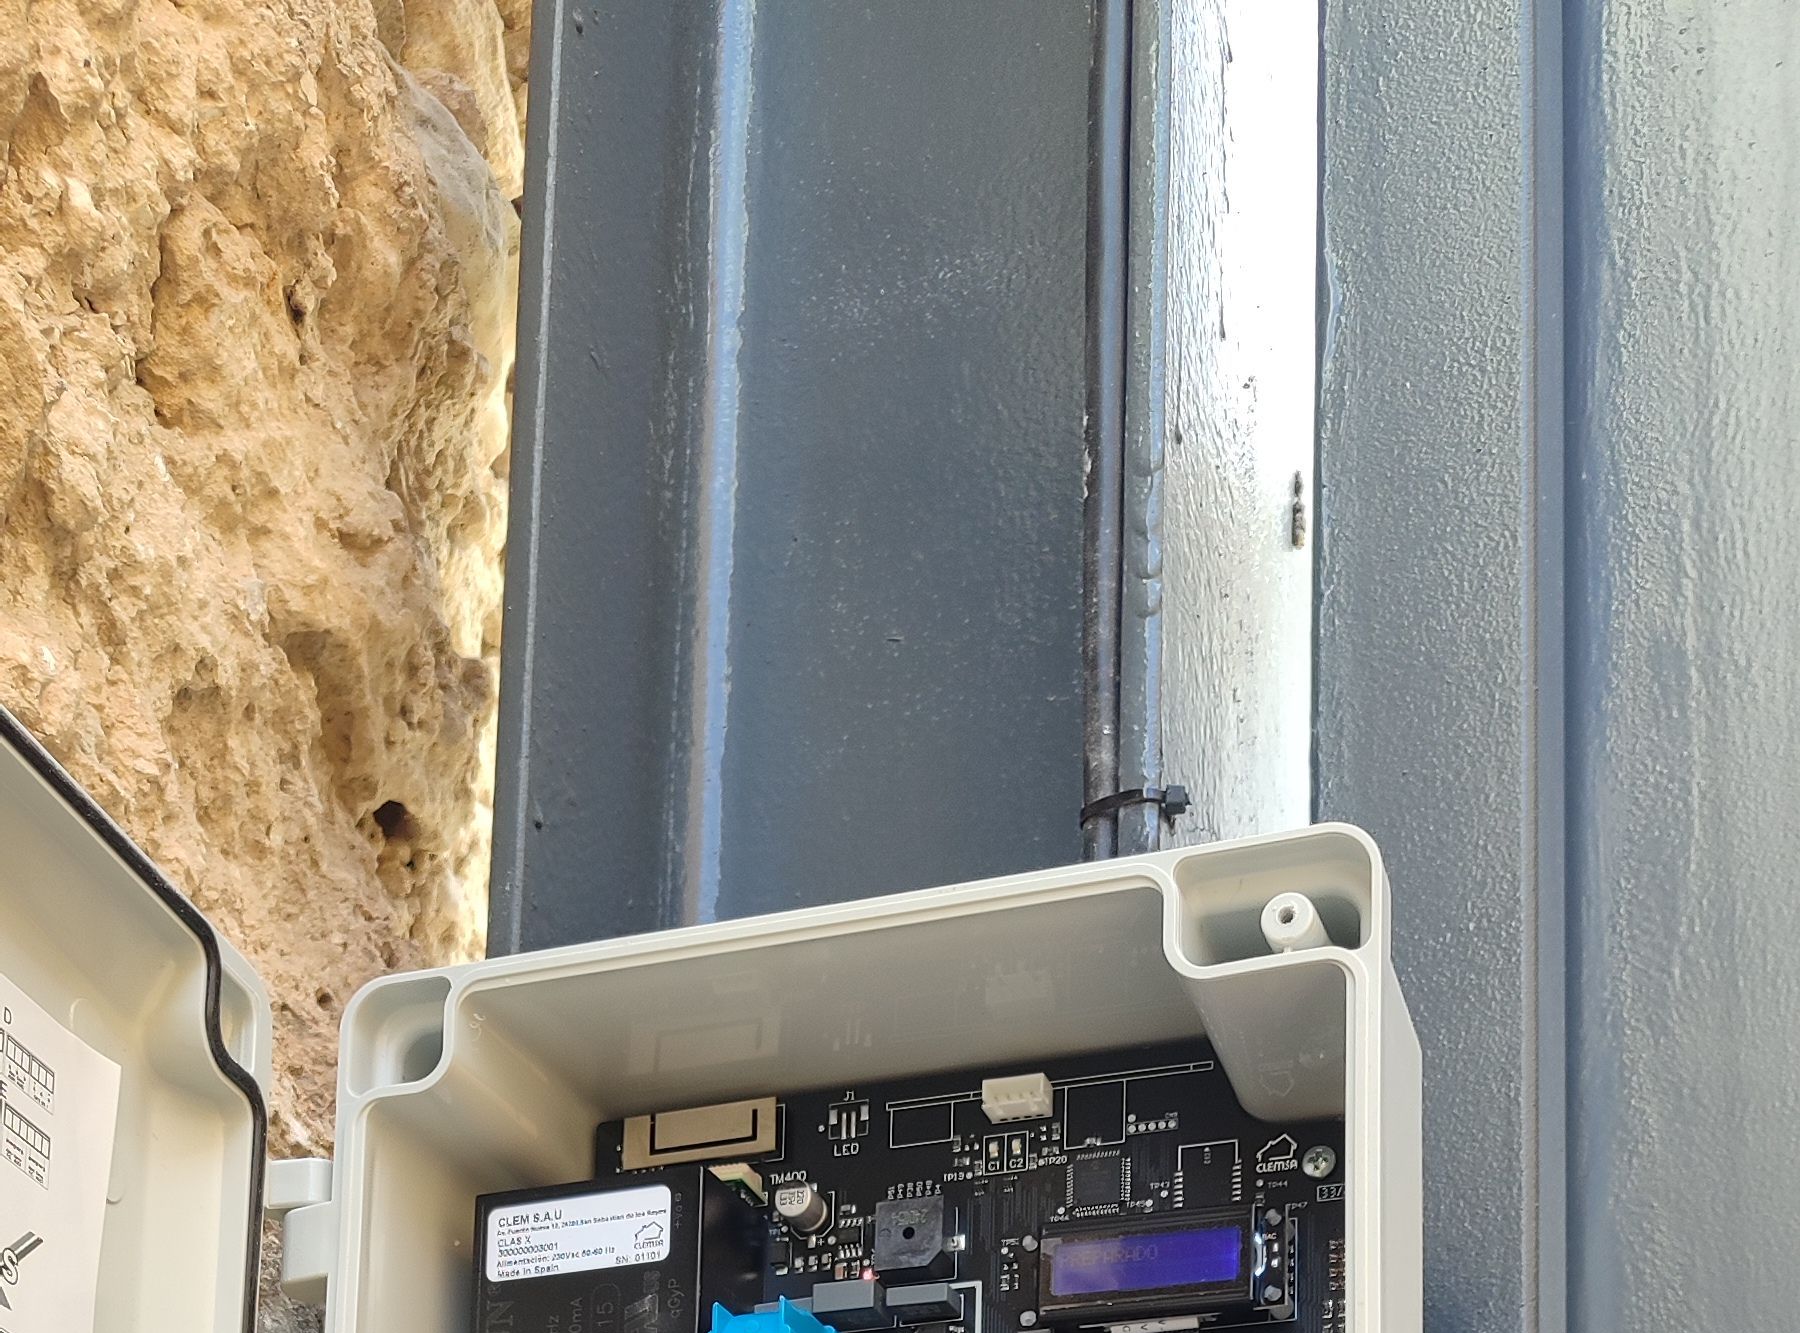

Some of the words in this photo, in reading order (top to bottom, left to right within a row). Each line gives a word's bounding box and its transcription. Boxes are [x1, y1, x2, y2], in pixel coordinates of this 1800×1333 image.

[834, 1143, 860, 1157] LED
[1256, 1160, 1298, 1173] CLEMSA
[498, 1215, 530, 1228] CLEM
[498, 1236, 523, 1248] CLAS
[534, 1264, 559, 1276] Spain
